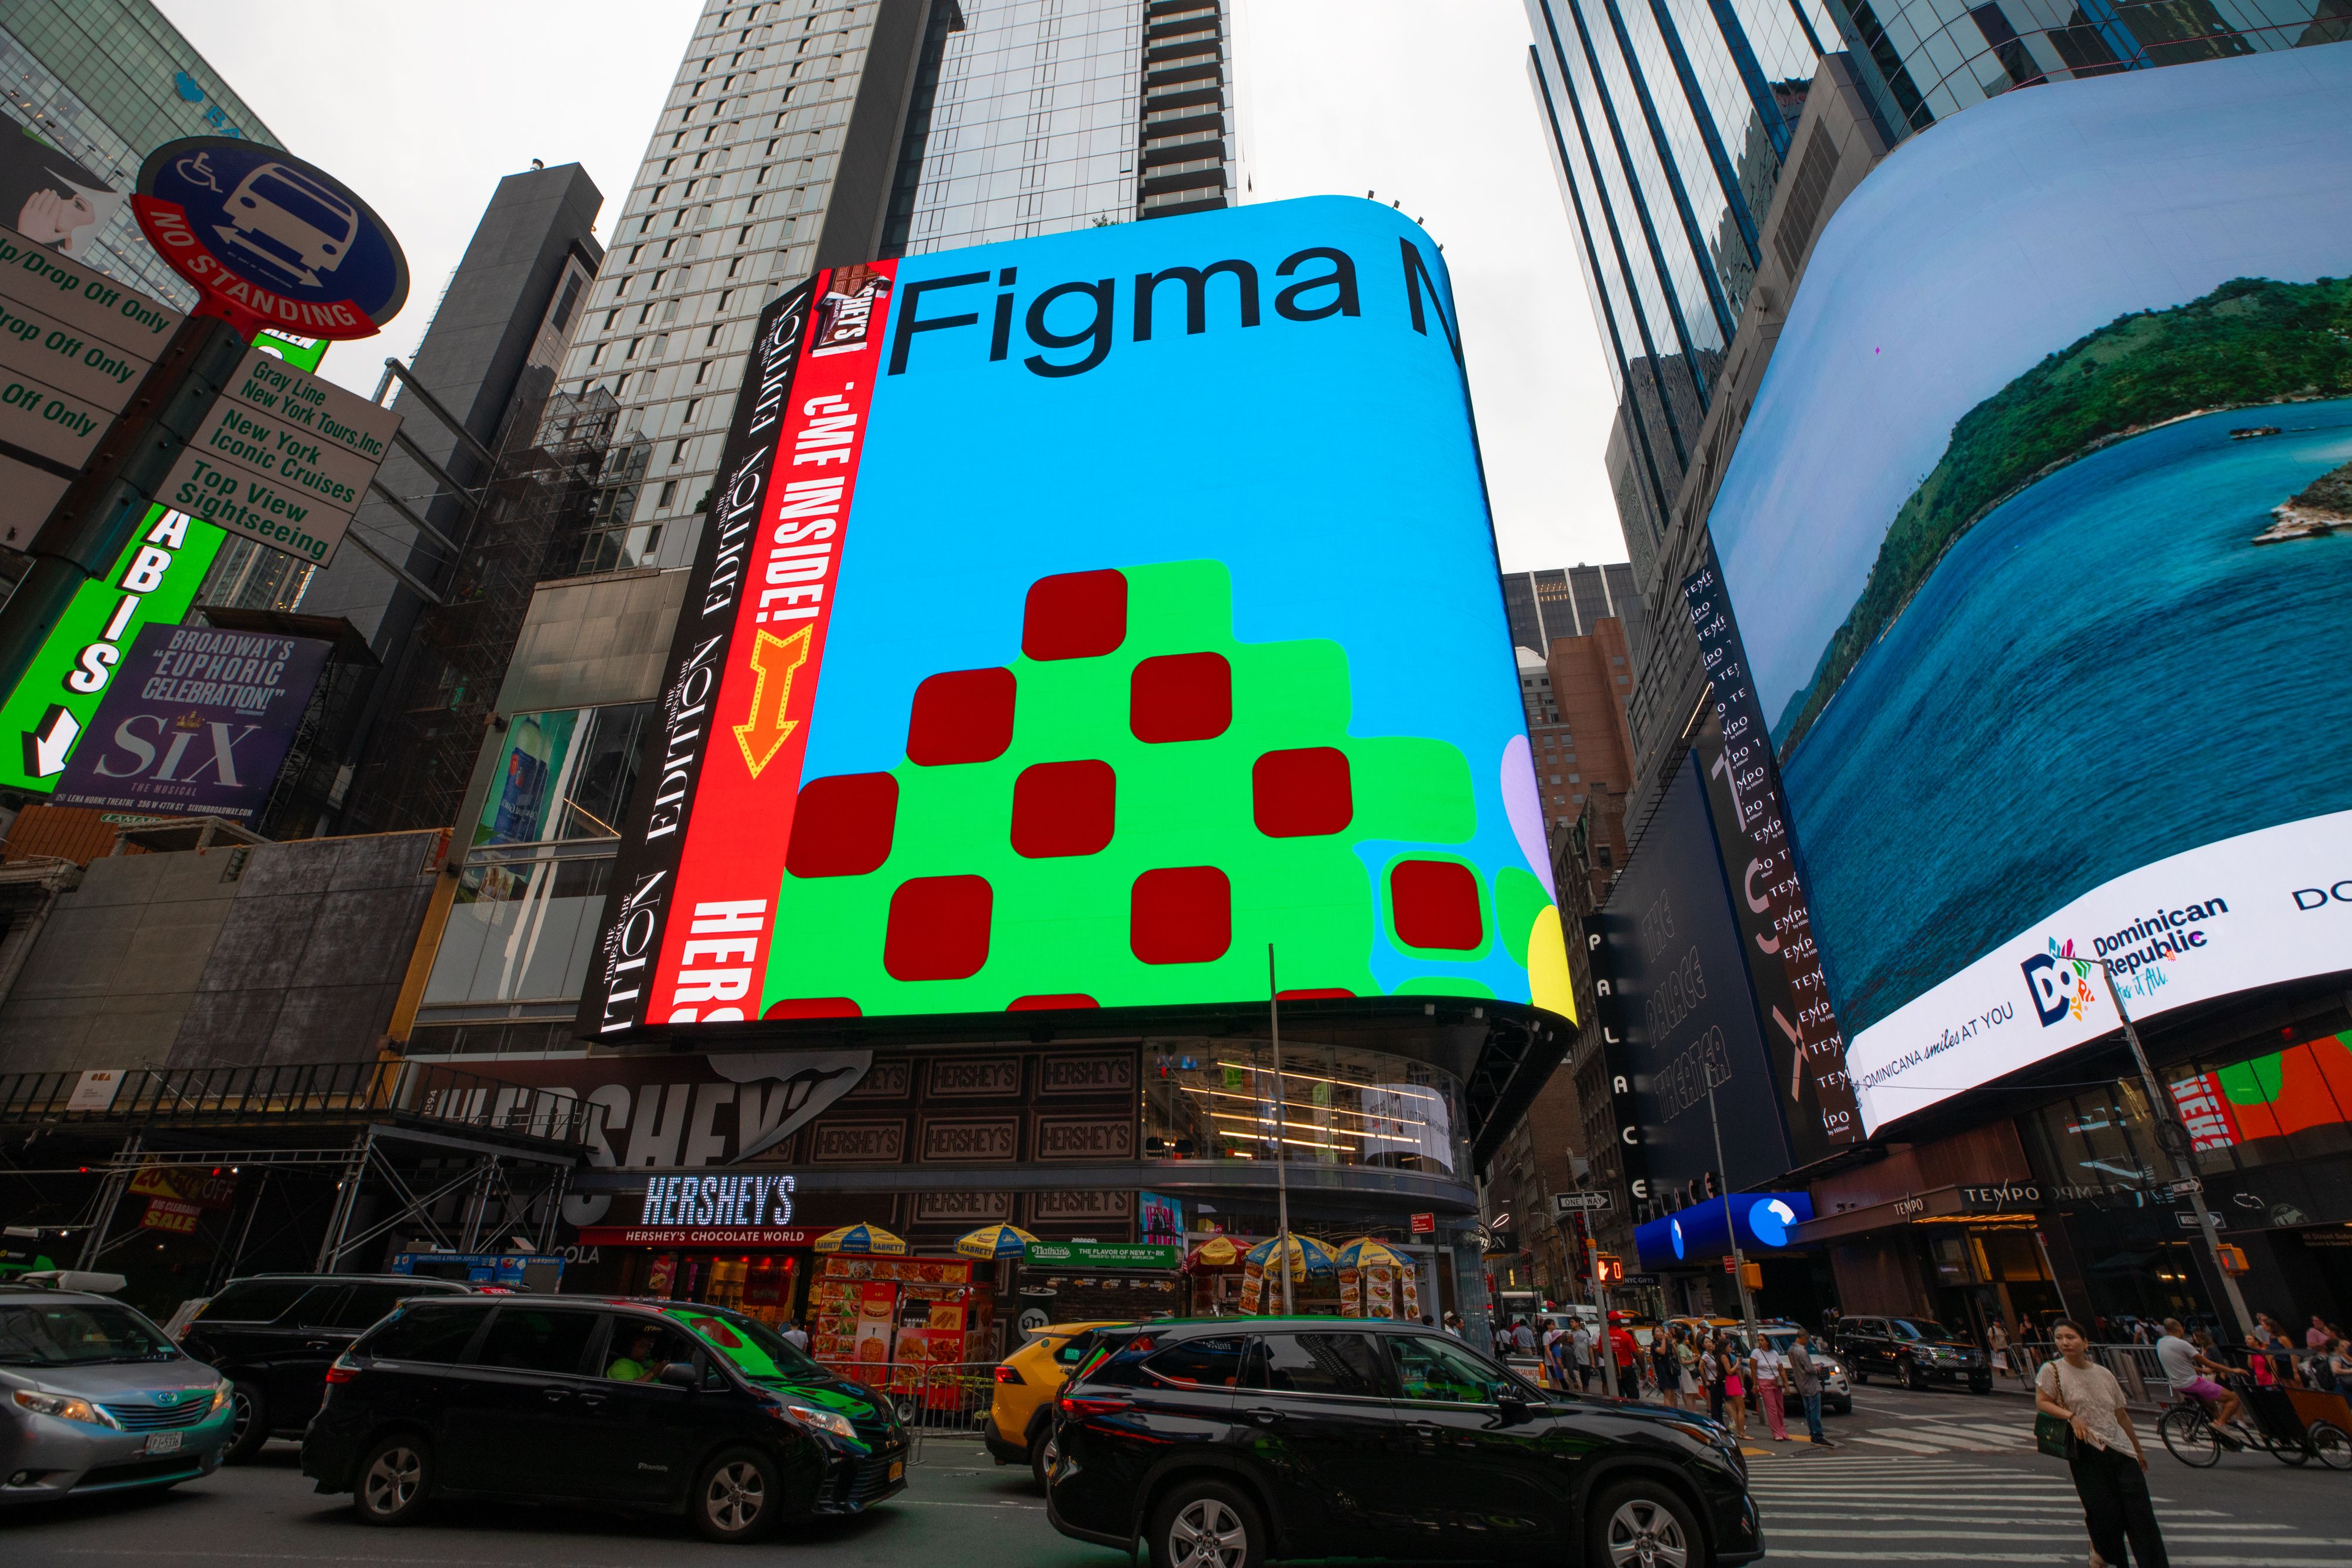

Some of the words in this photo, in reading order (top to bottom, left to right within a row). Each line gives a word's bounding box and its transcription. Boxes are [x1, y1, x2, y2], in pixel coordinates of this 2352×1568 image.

[150, 211, 195, 247] NO
[187, 255, 356, 326] STANDING
[84, 282, 121, 307] Off
[121, 299, 171, 334] Only
[888, 246, 1361, 378] Figma
[45, 331, 84, 358] Off
[84, 349, 136, 384] Only
[749, 292, 807, 438] EDITION
[240, 380, 277, 408] New
[280, 396, 316, 425] York
[253, 361, 292, 392] Gray
[292, 379, 326, 406] Line
[2, 384, 44, 411] Off
[42, 401, 98, 437] Only
[222, 409, 271, 443] New
[277, 432, 322, 466] York
[210, 429, 276, 469] Iconic
[281, 459, 355, 503] Cruises
[192, 460, 238, 496] Top
[248, 483, 308, 522] View
[176, 483, 328, 560] Sightseeing
[701, 446, 769, 620] EDITION
[756, 476, 846, 623] INSIDE!
[168, 630, 295, 660] BROADWAY'S
[1710, 657, 1722, 668] Hilton
[664, 686, 676, 710] THE
[666, 698, 680, 733] TIMES
[674, 658, 690, 700] SQUARE
[93, 714, 262, 788] SIX
[646, 634, 723, 845] EDITION
[1735, 726, 1748, 737] Hilton
[131, 783, 151, 791] THE
[153, 785, 197, 797] MUSICAL
[1750, 777, 1764, 788] Hilton
[67, 794, 85, 803] LENA
[85, 796, 106, 805] HORNE
[107, 798, 135, 807] THEATRE
[137, 800, 151, 808] 256
[159, 802, 175, 810] 47TH
[175, 803, 185, 811] ST
[188, 804, 253, 817] SIXONBROADWAY.COM
[603, 944, 619, 985] TIMES
[614, 894, 632, 944] SQUARE
[603, 927, 616, 954] THE
[1641, 889, 1674, 963] THE
[2093, 897, 2229, 958] Dominican
[2105, 929, 2207, 977] Republic
[1646, 945, 1706, 1049] PALACE
[1924, 1029, 1959, 1059] smiles
[1962, 1019, 1976, 1041] AT
[1980, 1002, 2013, 1029] YOU
[934, 1062, 1015, 1088] HERSHEY'S
[1047, 1059, 1130, 1085] HERSHEY'S
[1589, 934, 1648, 1198] PALACE
[1653, 1025, 1732, 1124] THEATER
[817, 1128, 898, 1155] HERSHEY'S
[928, 1126, 1012, 1153] HERSHEY'S
[1043, 1124, 1128, 1151] HERSHEY'S
[1833, 1124, 1850, 1134] Hilton
[151, 1199, 166, 1210] BIG
[164, 1201, 202, 1216] CLEARANCE
[640, 1175, 797, 1226] HERSHEY'S
[1893, 1194, 1924, 1220] TEMPO
[1964, 1181, 2040, 1208] TEMPO
[2187, 1181, 2197, 1189] WAY
[145, 1211, 198, 1232] SALE
[626, 1231, 686, 1242] HERSHEY'S
[690, 1231, 760, 1242] CHOCOLATE
[763, 1232, 805, 1242] WORLD
[873, 1243, 903, 1252] SABRETT
[960, 1245, 993, 1256] SABRETT
[1031, 1245, 1071, 1256] Nathan's
